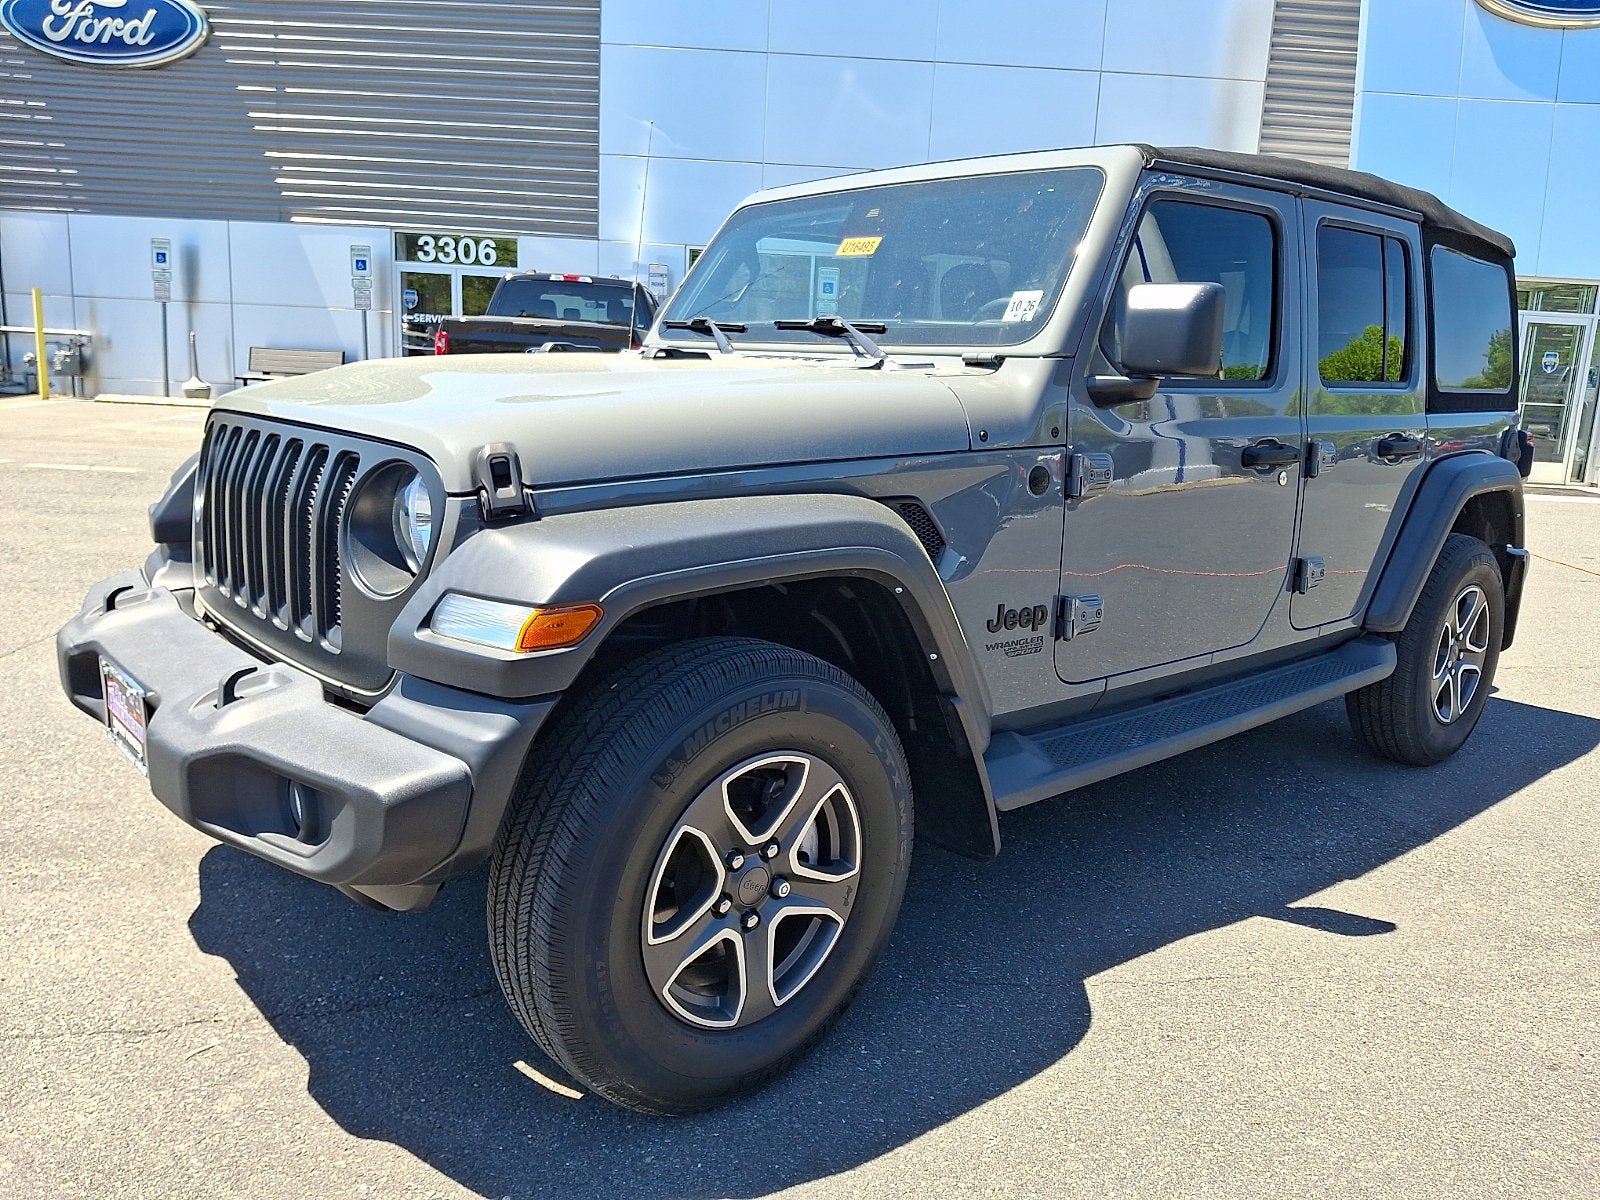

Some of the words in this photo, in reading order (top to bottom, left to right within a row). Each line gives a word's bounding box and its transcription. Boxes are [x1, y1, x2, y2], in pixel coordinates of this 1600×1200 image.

[42, 0, 157, 46] Ford
[417, 235, 497, 266] 3306
[987, 604, 1048, 633] Jeep
[985, 636, 1044, 652] WRANGLER
[682, 688, 800, 758] MICHELIN
